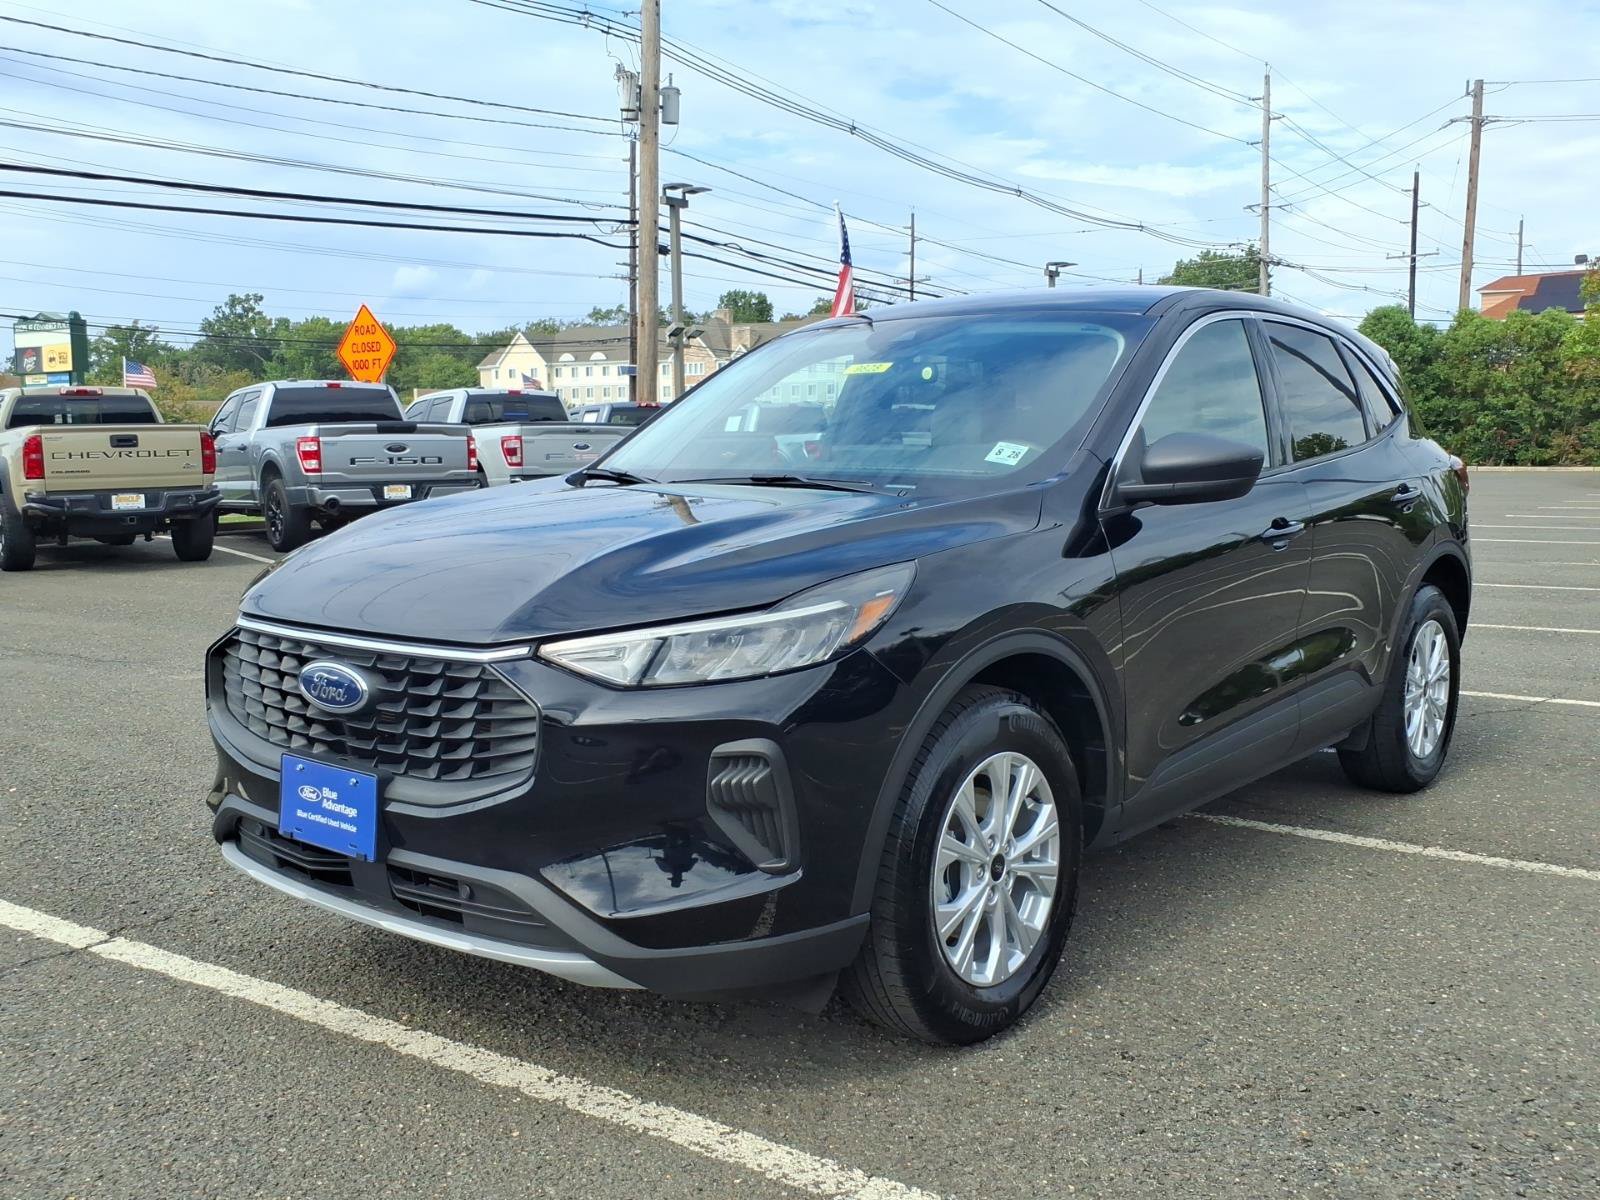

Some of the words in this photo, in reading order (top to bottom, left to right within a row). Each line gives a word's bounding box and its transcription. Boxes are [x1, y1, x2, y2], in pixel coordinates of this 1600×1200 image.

[354, 324, 377, 336] ROAD
[351, 341, 381, 353] CLOSED
[352, 359, 370, 370] 1000
[372, 358, 382, 369] FT
[51, 449, 195, 460] CHEVROLET
[350, 456, 443, 466] F-150
[310, 671, 348, 702] Ford
[322, 787, 338, 800] Blue
[322, 799, 358, 818] Advantage
[296, 809, 308, 819] Blue
[308, 812, 328, 824] Certified
[327, 818, 340, 827] Used
[340, 821, 358, 832] Vehicle
